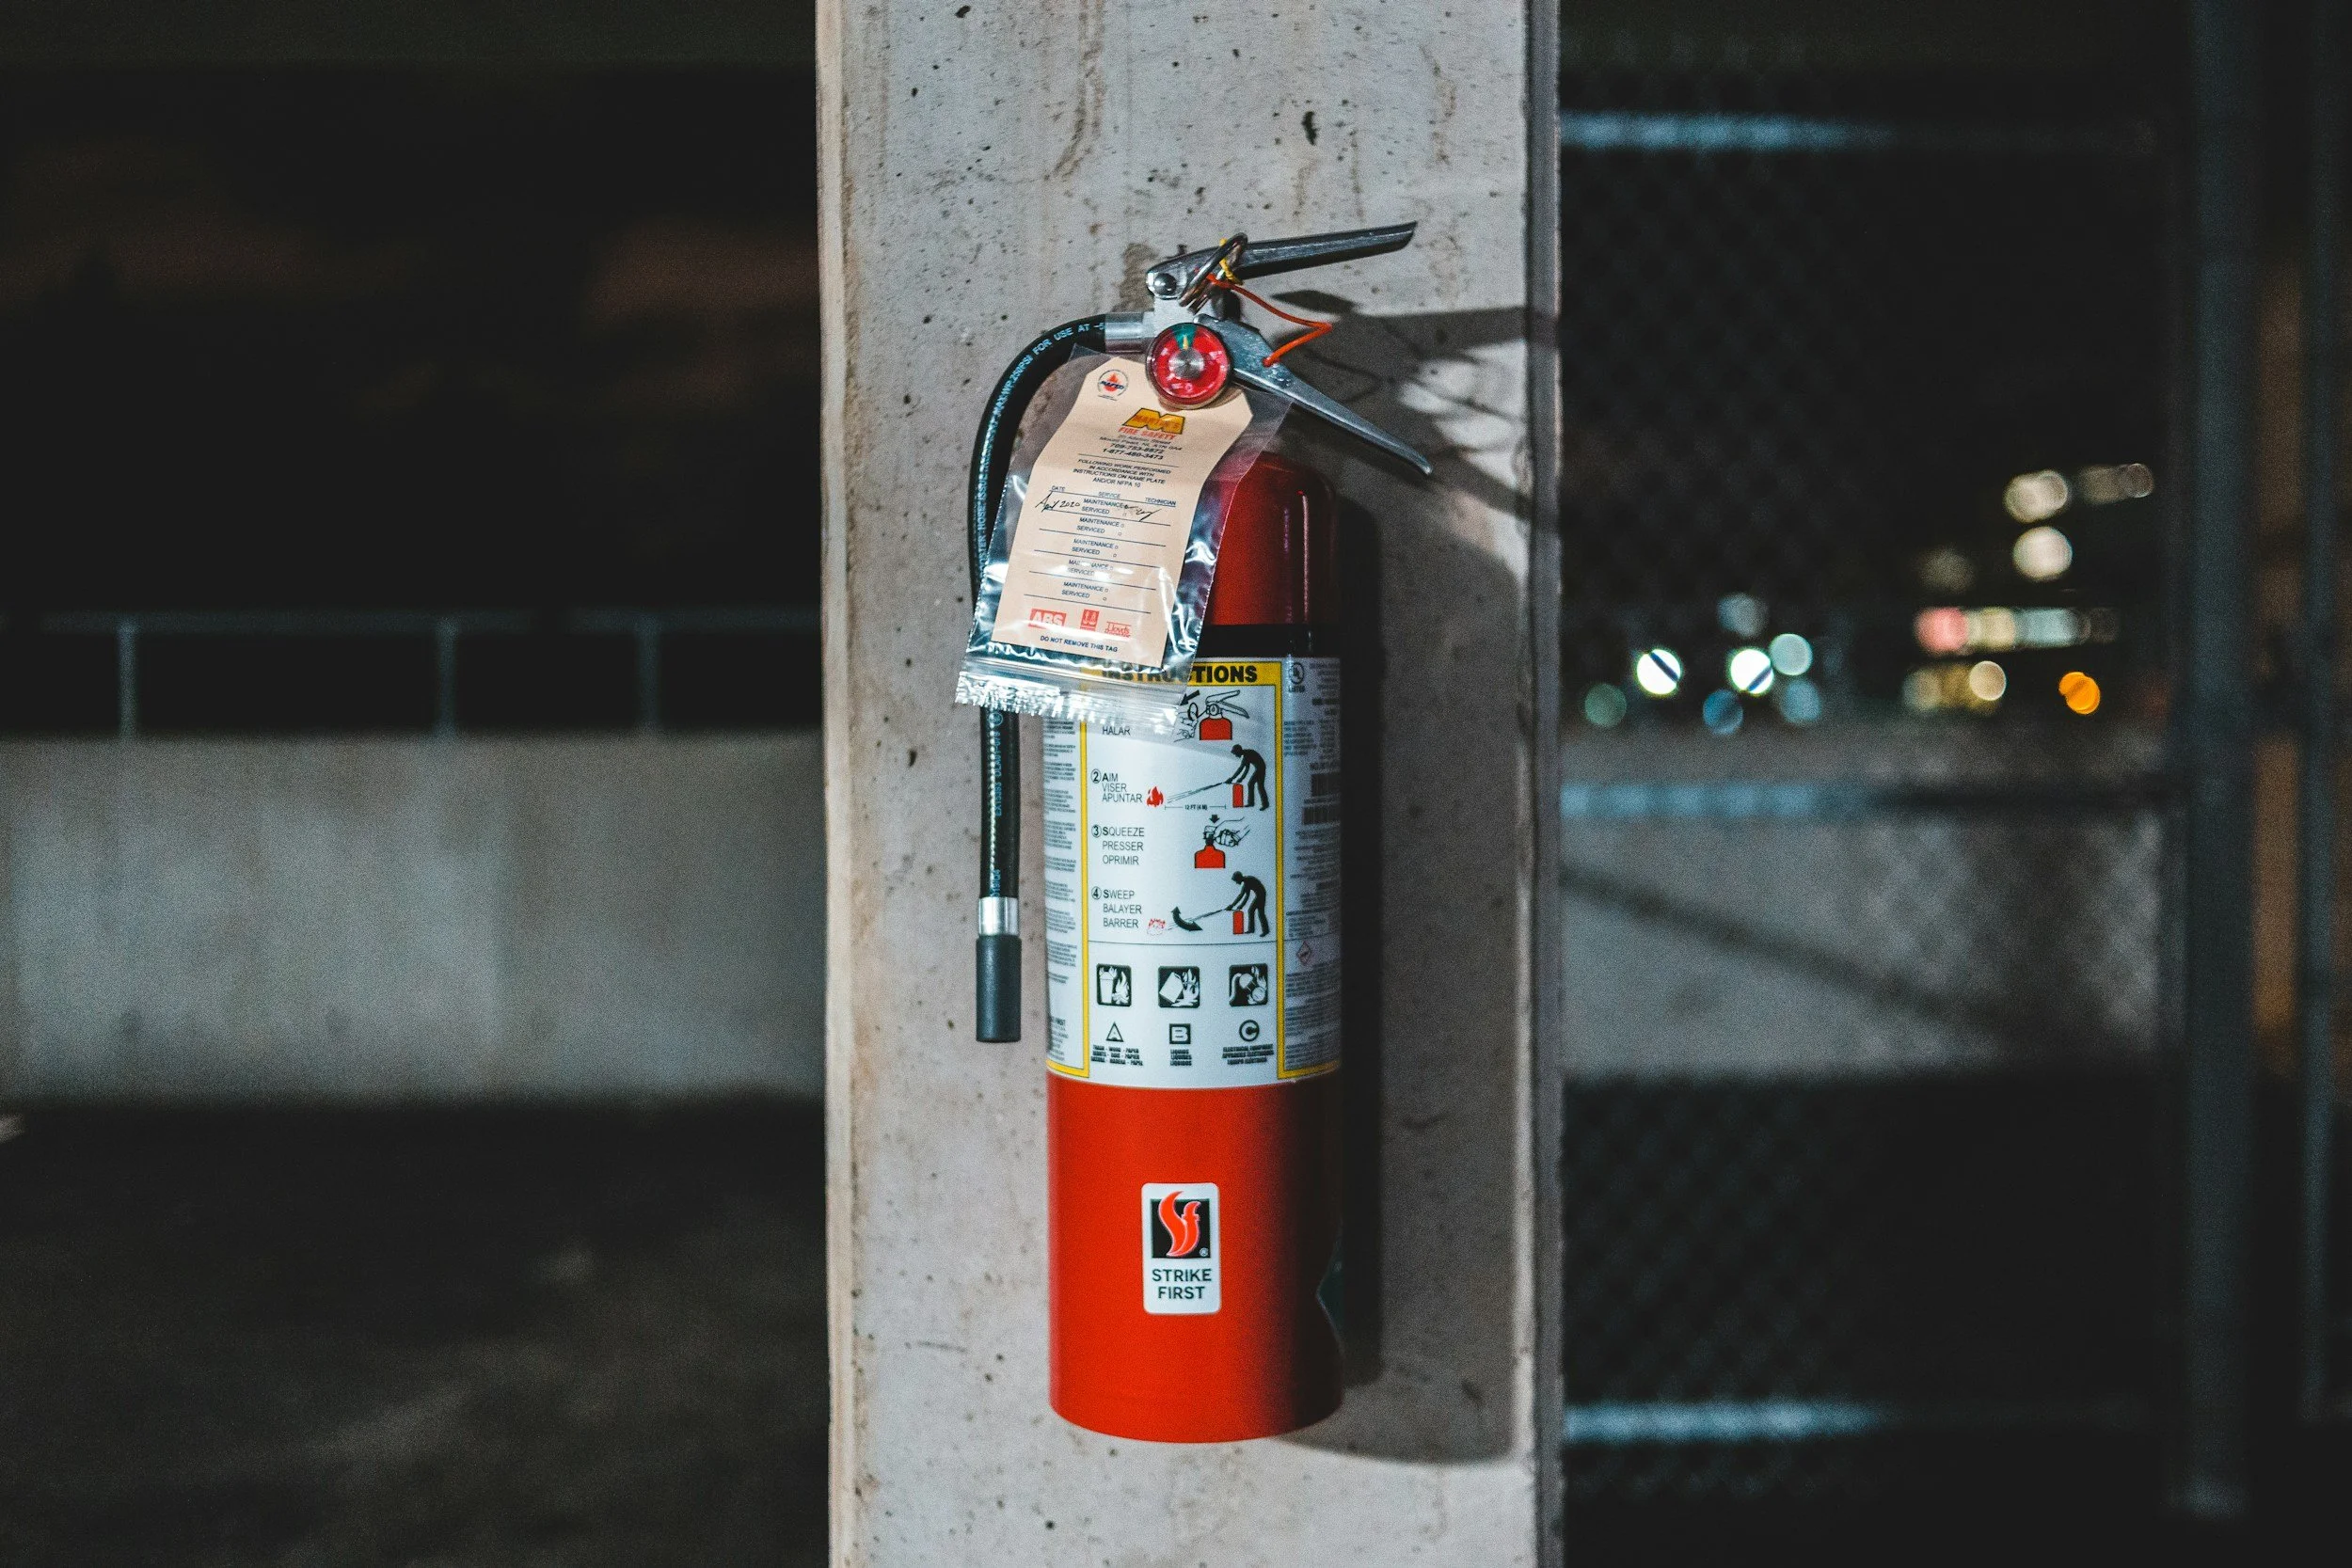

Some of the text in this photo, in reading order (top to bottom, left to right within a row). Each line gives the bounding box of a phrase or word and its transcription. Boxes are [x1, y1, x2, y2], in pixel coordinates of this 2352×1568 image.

[1032, 339, 1053, 356] FOR
[1054, 327, 1074, 341] USE
[1078, 324, 1090, 333] AT
[1078, 459, 1112, 467] FOLLOWING
[1134, 466, 1171, 475] PERFORMED
[1096, 466, 1139, 475] ACCORDANCE
[1073, 468, 1117, 478] INSTRUCTIONS
[1083, 498, 1123, 508] MAINTENANCE
[1145, 497, 1176, 506] TECHNICIAN
[1081, 506, 1110, 515] SERVICED
[1079, 517, 1120, 527] MAINTENANCE
[1077, 525, 1105, 534] SERVICED
[1073, 539, 1114, 549] MAINTENANCE
[1072, 546, 1100, 555] SERVICED
[1064, 581, 1104, 592] MAINTENANCE
[1062, 589, 1090, 598] SERVICED
[1032, 610, 1065, 626] ABS
[1064, 639, 1089, 648] REMOVE
[1102, 726, 1130, 736] HALAR
[1102, 773, 1119, 782] AIM
[1102, 783, 1127, 792] VISER
[1102, 793, 1143, 803] APUNTAR
[1102, 826, 1145, 837] SQUEEZE
[1102, 840, 1144, 851] PRESSER
[1102, 855, 1139, 865] OPRIMIR
[1103, 889, 1135, 900] SWEEP
[1103, 903, 1142, 914] BALAYER
[1103, 918, 1139, 928] BARRER
[1171, 1025, 1189, 1043] B
[1152, 1268, 1212, 1282] STRIKE
[1158, 1286, 1206, 1299] FIRST
